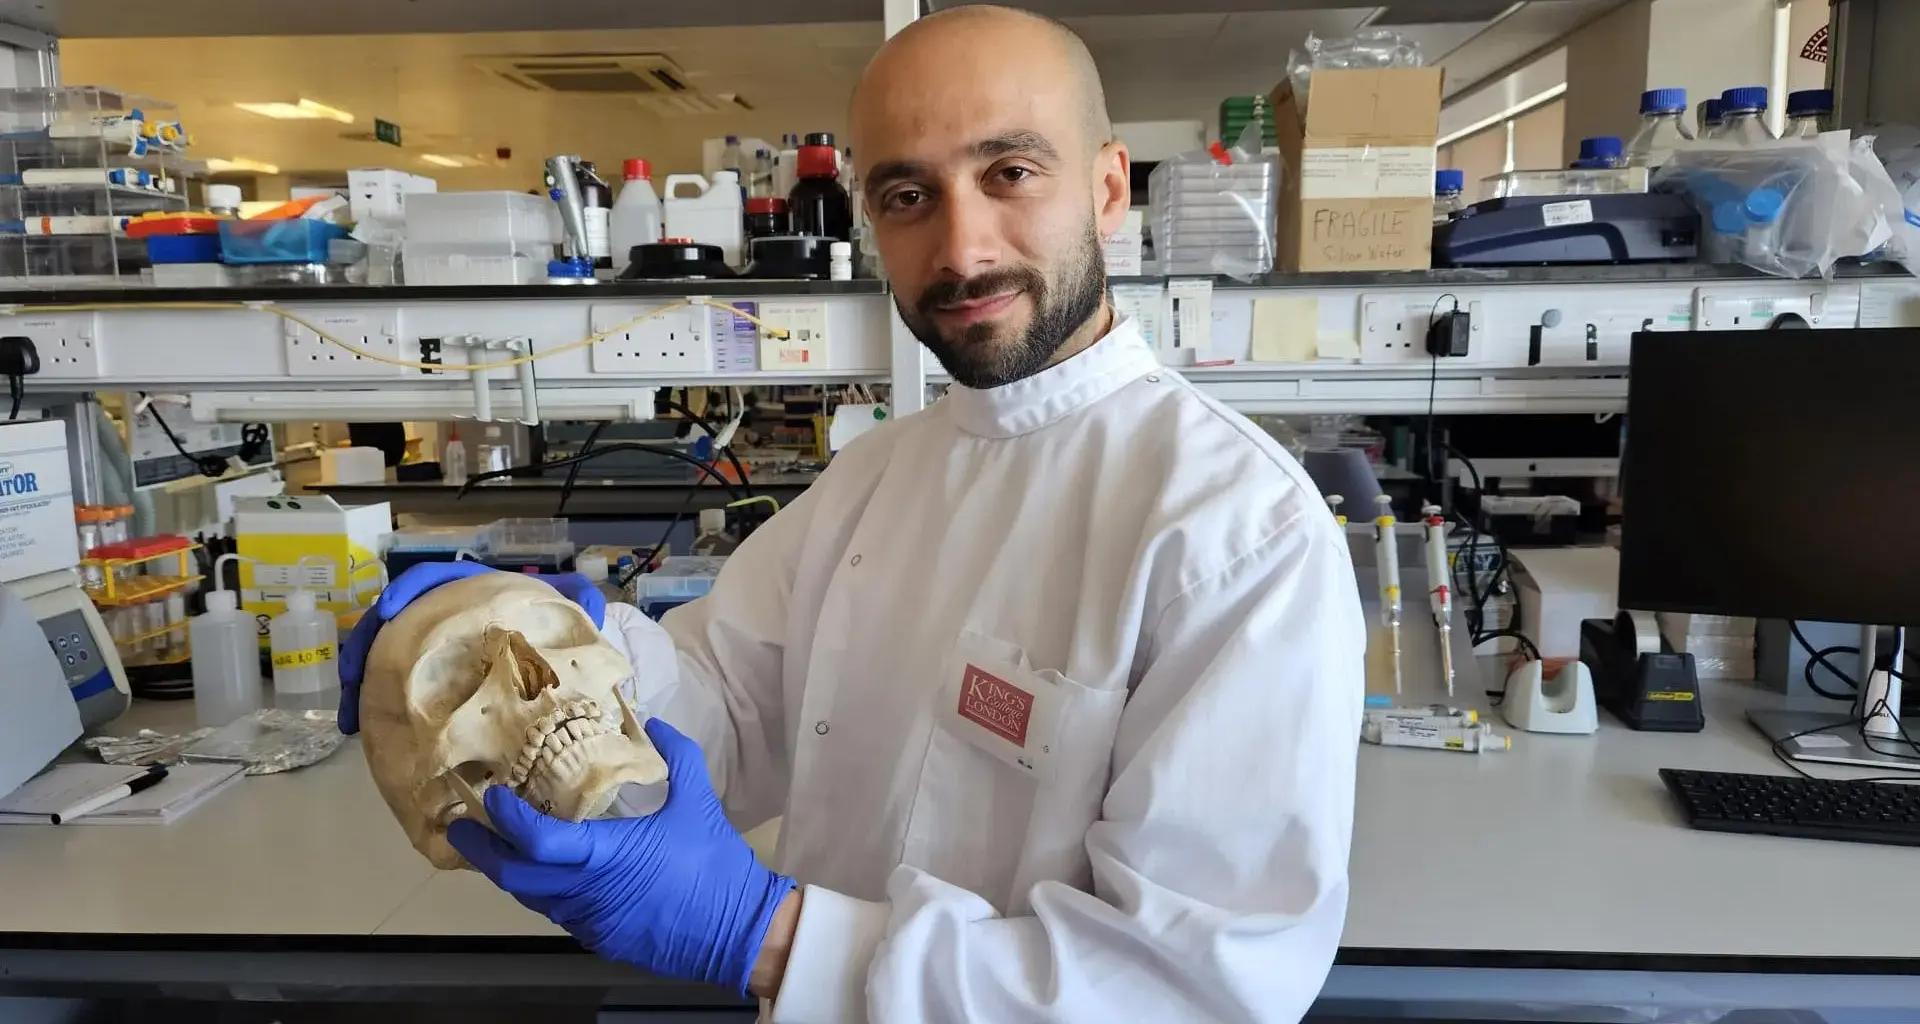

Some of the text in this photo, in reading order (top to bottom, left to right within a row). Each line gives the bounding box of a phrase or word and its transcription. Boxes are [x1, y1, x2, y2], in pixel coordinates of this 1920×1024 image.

[1312, 208, 1411, 242] FRAGILE
[967, 674, 1025, 711] KING'S
[986, 695, 1024, 719] College
[966, 696, 1022, 732] LONDON
